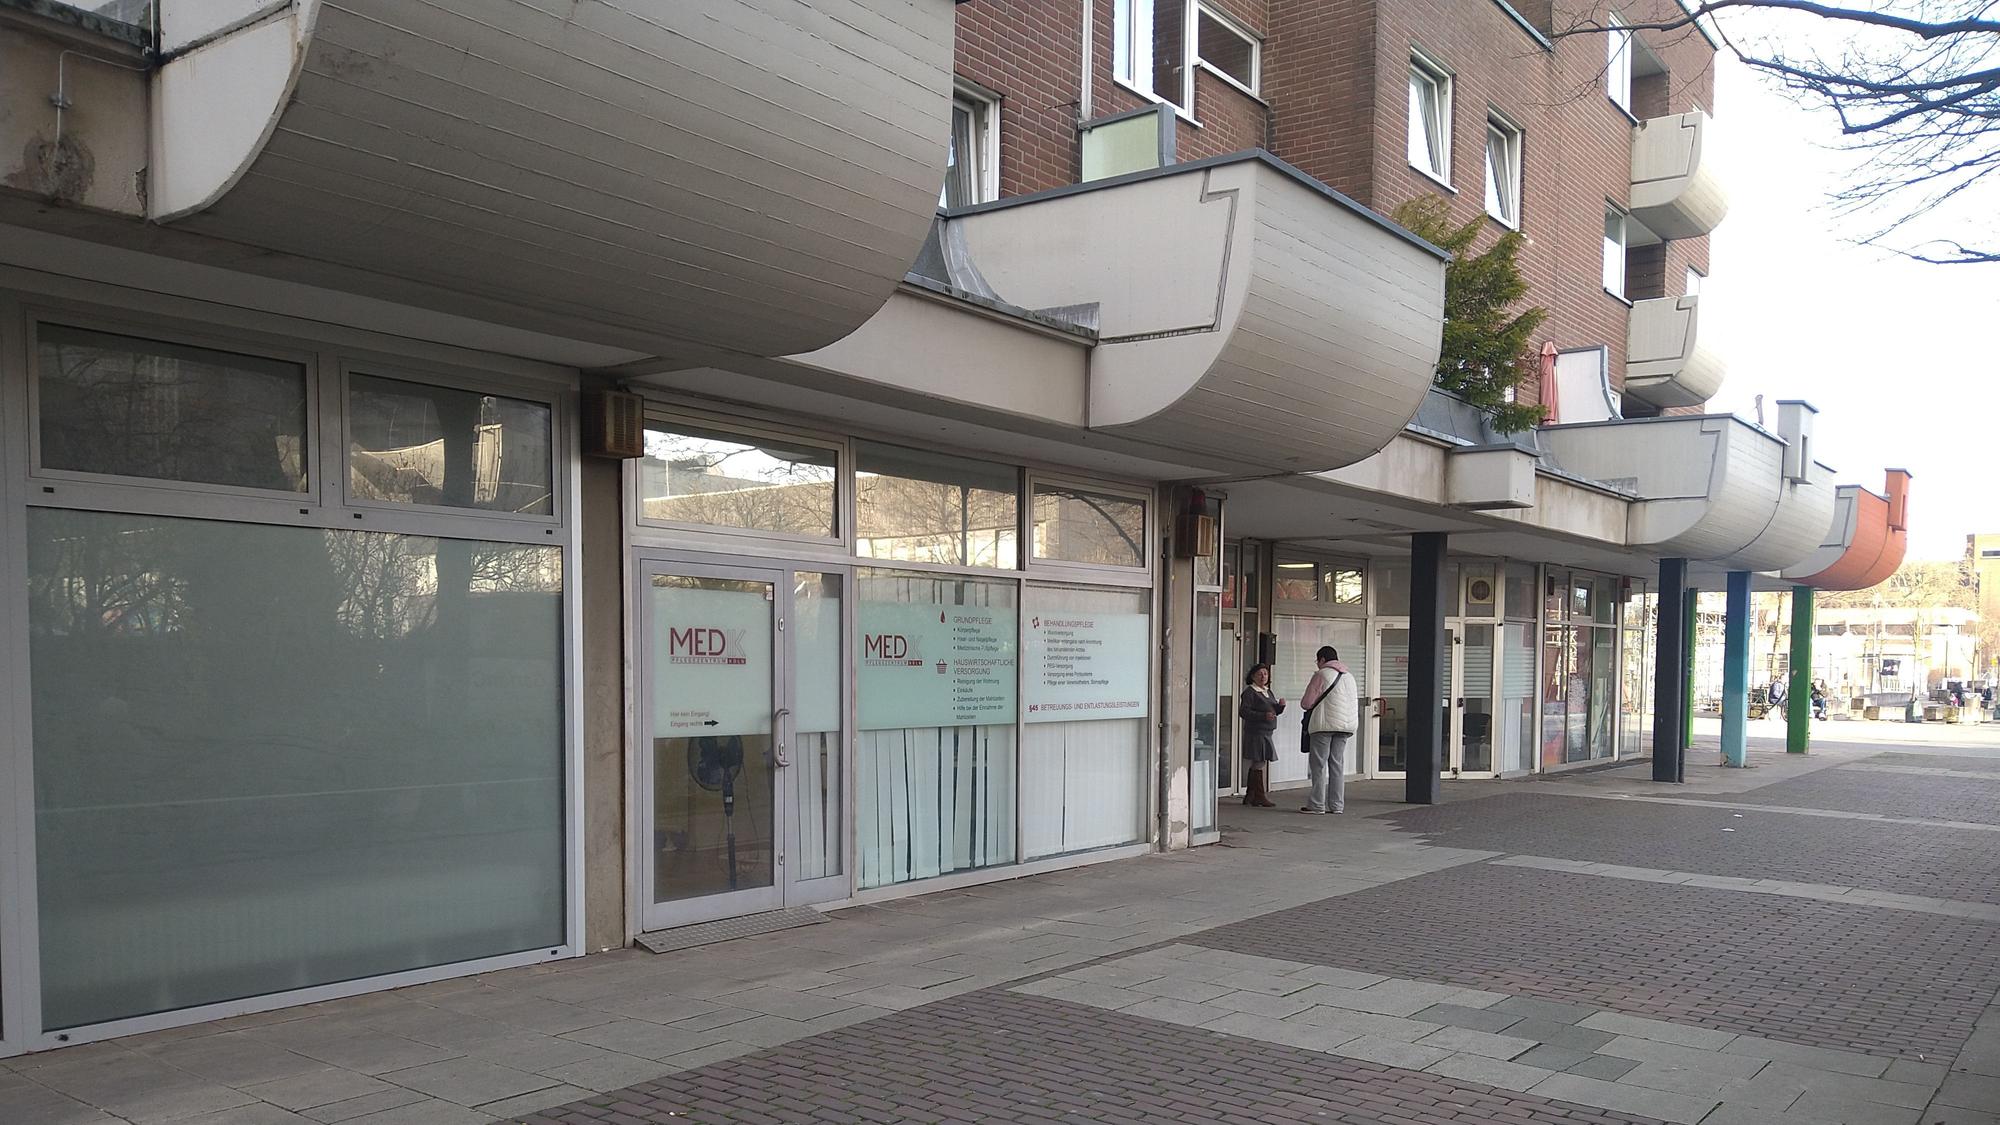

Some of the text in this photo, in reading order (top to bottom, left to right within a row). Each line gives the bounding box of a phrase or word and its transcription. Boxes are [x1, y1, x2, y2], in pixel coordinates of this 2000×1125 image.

[953, 616, 992, 624] GRUNDPFLEGE
[1044, 619, 1094, 628] BEHANDLUNGSPFLEGE
[1029, 704, 1038, 712] §45
[1084, 701, 1140, 710] ENTLASTUNGSLEISTUNGEN
